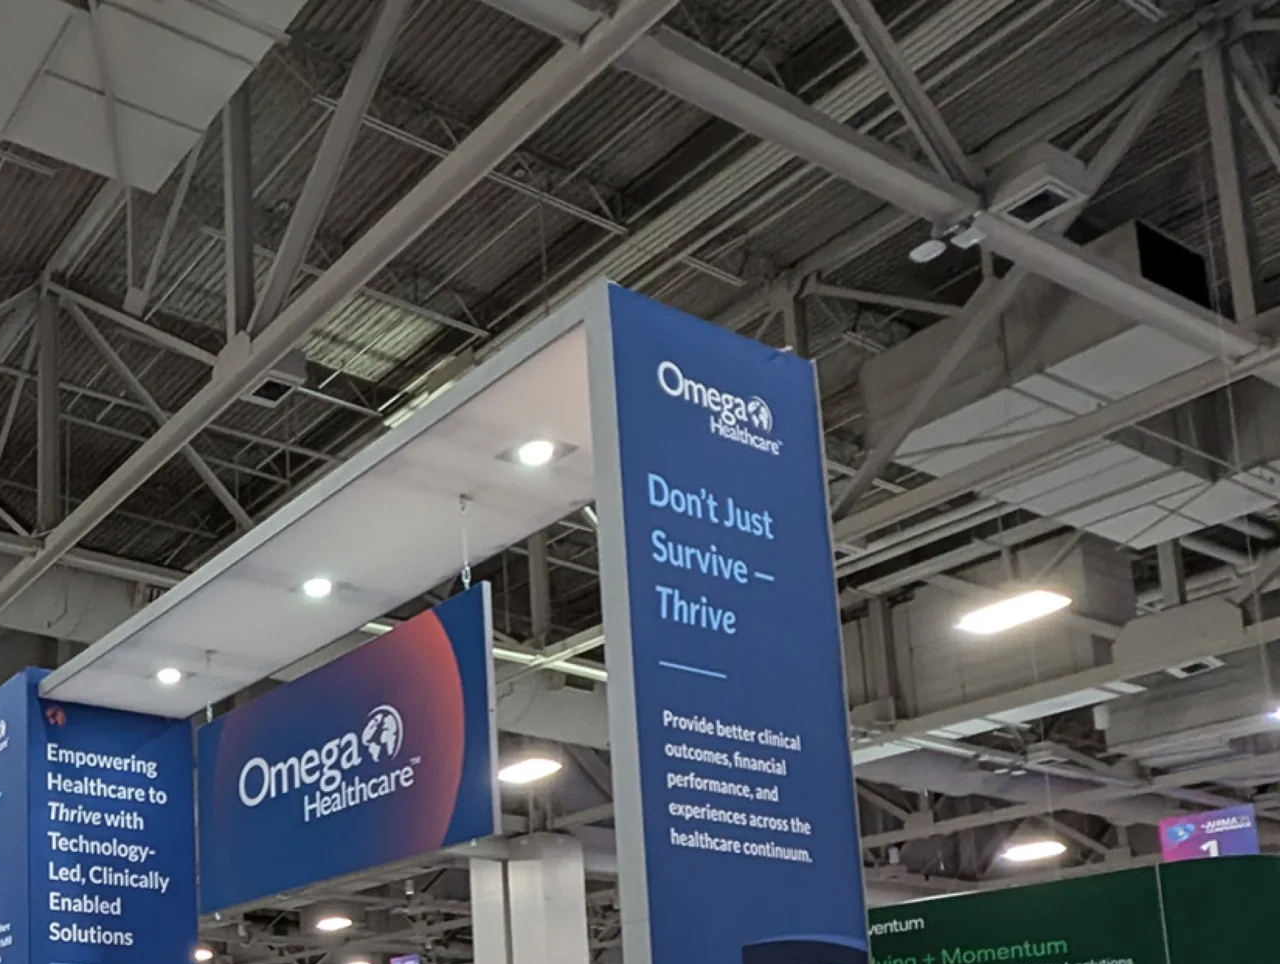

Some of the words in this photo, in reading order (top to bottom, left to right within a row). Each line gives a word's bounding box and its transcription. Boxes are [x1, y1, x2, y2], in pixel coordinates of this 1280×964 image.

[657, 361, 748, 425] Omega
[648, 473, 719, 523] Don't
[723, 498, 774, 539] Just
[651, 530, 748, 583] Survive
[655, 585, 736, 634] Thrive
[663, 709, 714, 735] Provide
[716, 720, 756, 743] better
[758, 728, 801, 752] clinical
[47, 743, 158, 779] Empowering
[239, 732, 362, 807] Omega
[665, 742, 733, 769] outcomes,
[733, 751, 787, 776] financial
[47, 772, 146, 803] Healthcare
[148, 787, 167, 804] to
[667, 771, 753, 800] performance,
[755, 784, 779, 803] and
[48, 801, 102, 826] Thrive
[104, 810, 144, 830] with
[668, 801, 747, 827] experiences
[749, 812, 789, 832] across
[790, 816, 811, 835] the
[47, 831, 156, 863] Technology-
[670, 827, 741, 854] healthcare
[743, 840, 813, 863] continuum.
[48, 861, 87, 886] Led,
[89, 866, 170, 893] Clinically
[49, 891, 122, 916] Enabled
[49, 922, 134, 946] Solutions
